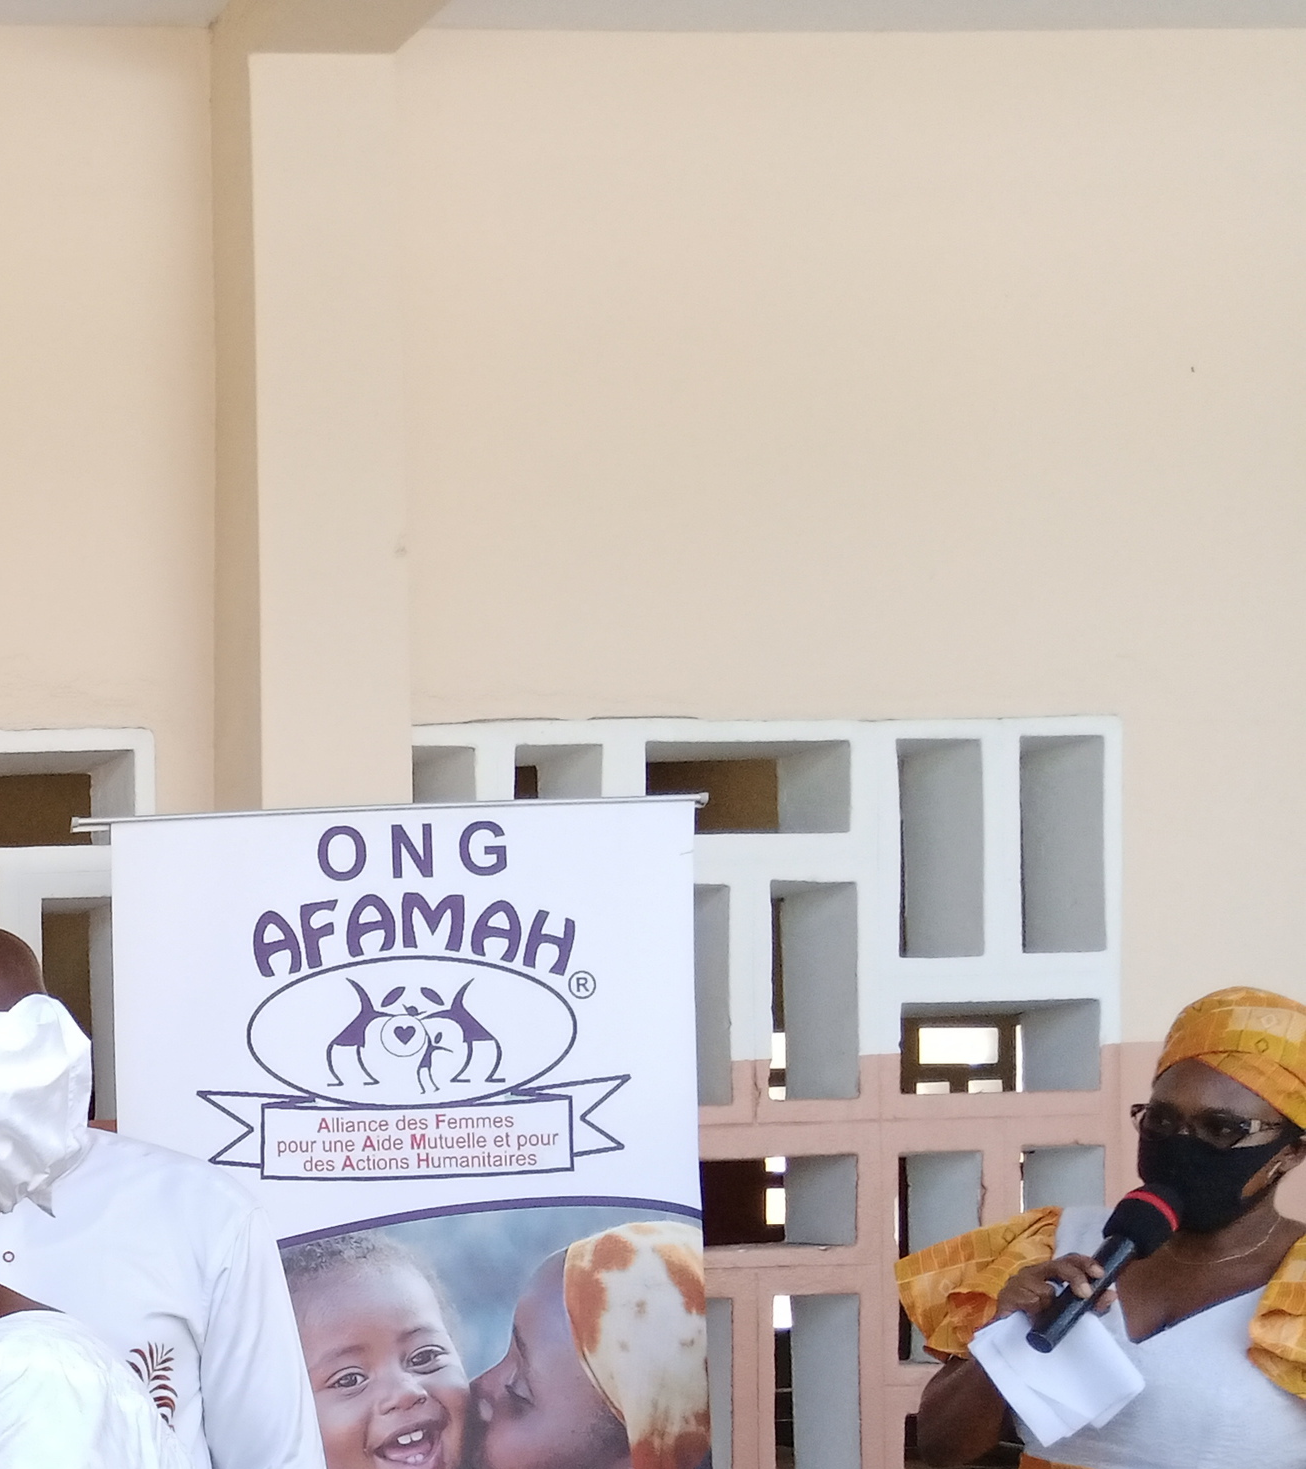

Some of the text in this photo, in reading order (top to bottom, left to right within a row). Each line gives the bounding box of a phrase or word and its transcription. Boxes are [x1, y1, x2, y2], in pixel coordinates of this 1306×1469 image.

[317, 820, 508, 881] ONG
[252, 892, 576, 978] AFAMAH
[317, 1113, 515, 1133] Alliance des Femmes
[277, 1132, 559, 1157] pour une Aide Mutuelle et pour
[303, 1151, 538, 1173] des Actions Humanitaires
